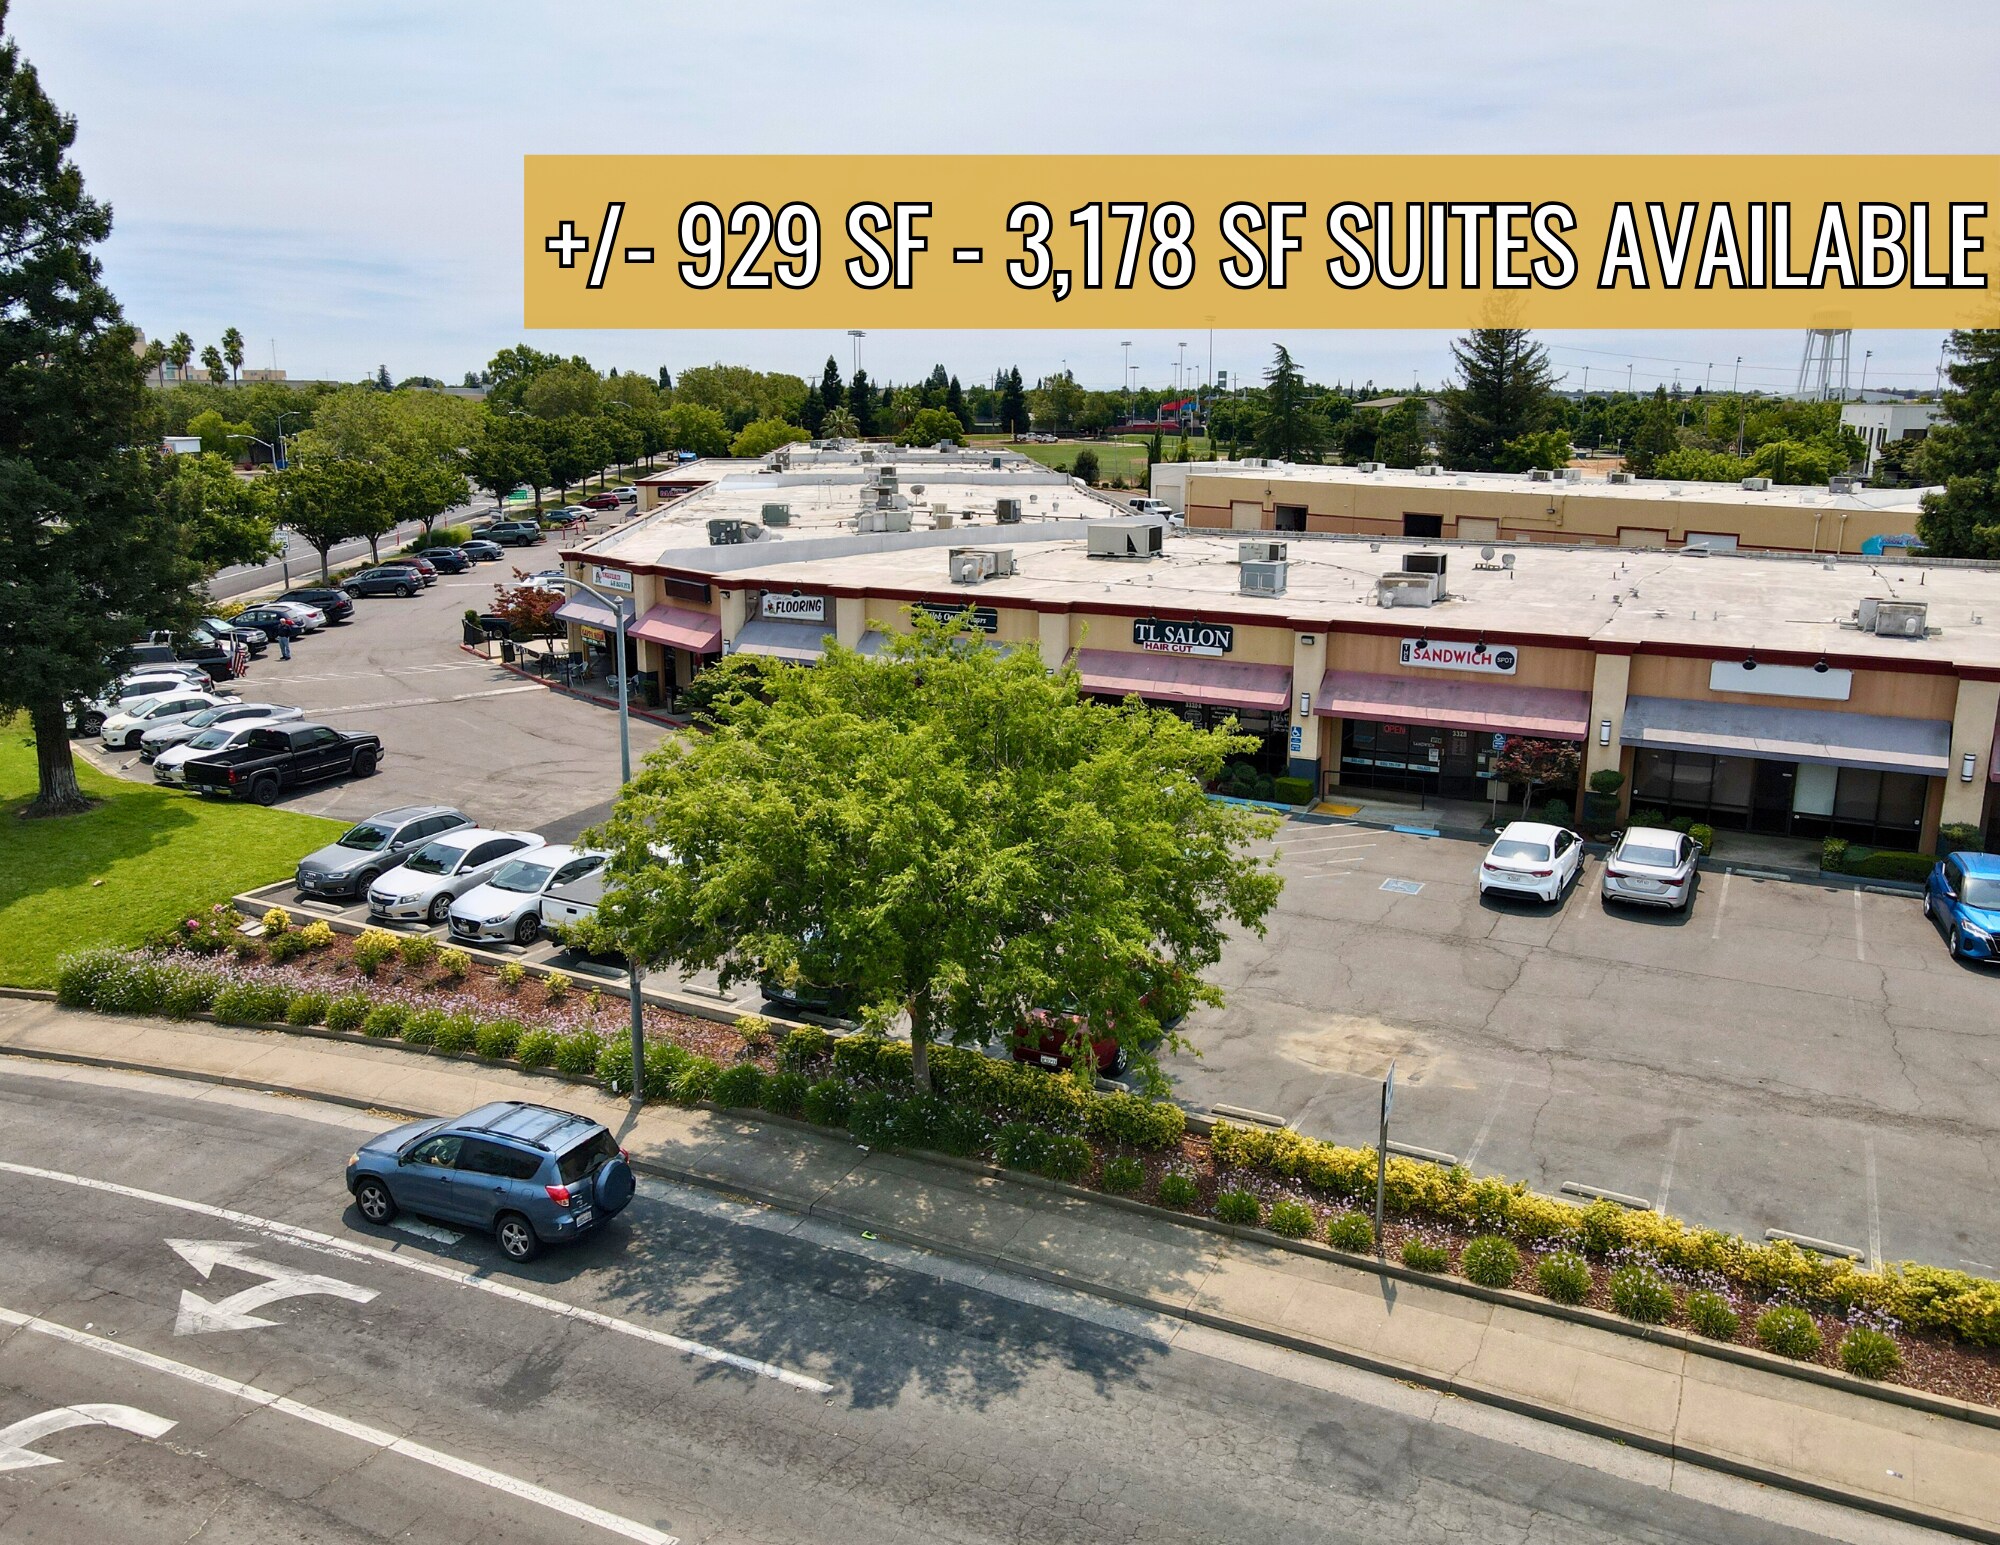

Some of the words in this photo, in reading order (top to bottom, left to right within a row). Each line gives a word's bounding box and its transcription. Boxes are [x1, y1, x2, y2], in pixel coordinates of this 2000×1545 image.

[776, 599, 822, 613] FLOORING
[1135, 623, 1160, 641] TL
[1164, 626, 1231, 648] SALON
[1145, 642, 1169, 650] HAIR
[1171, 644, 1193, 653] CUT
[1413, 648, 1492, 665] SANDWICH
[1383, 725, 1406, 734] OPEN
